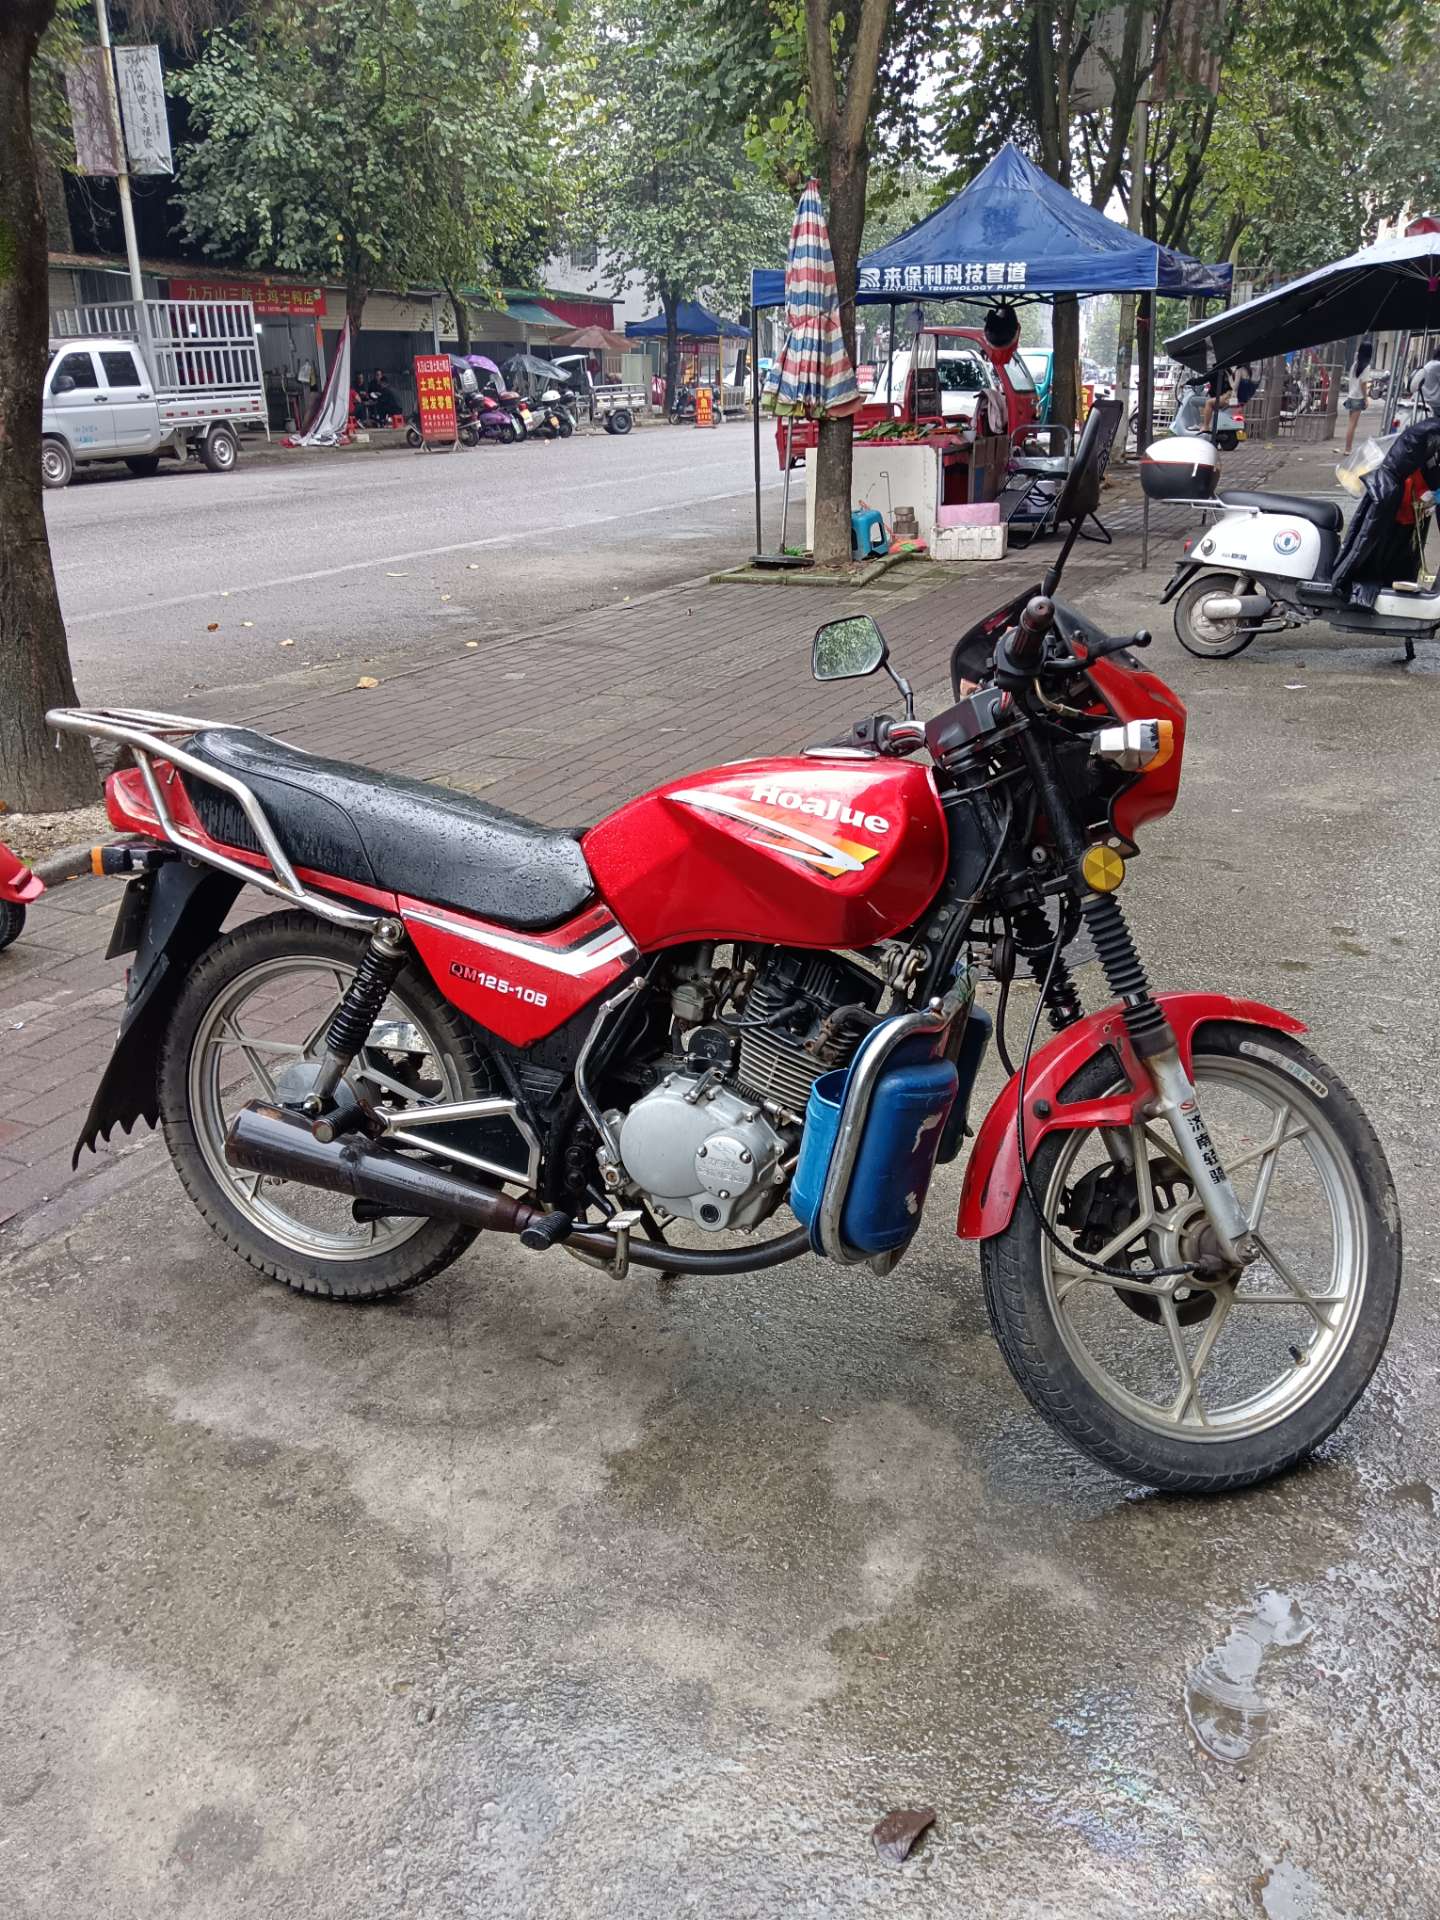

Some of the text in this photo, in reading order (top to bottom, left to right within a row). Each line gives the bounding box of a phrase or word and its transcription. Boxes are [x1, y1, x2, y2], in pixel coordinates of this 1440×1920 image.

[884, 262, 1027, 288] 来保利科技管道
[420, 375, 451, 391] 土鸡土鸭
[450, 963, 549, 1007] QM125-10B
